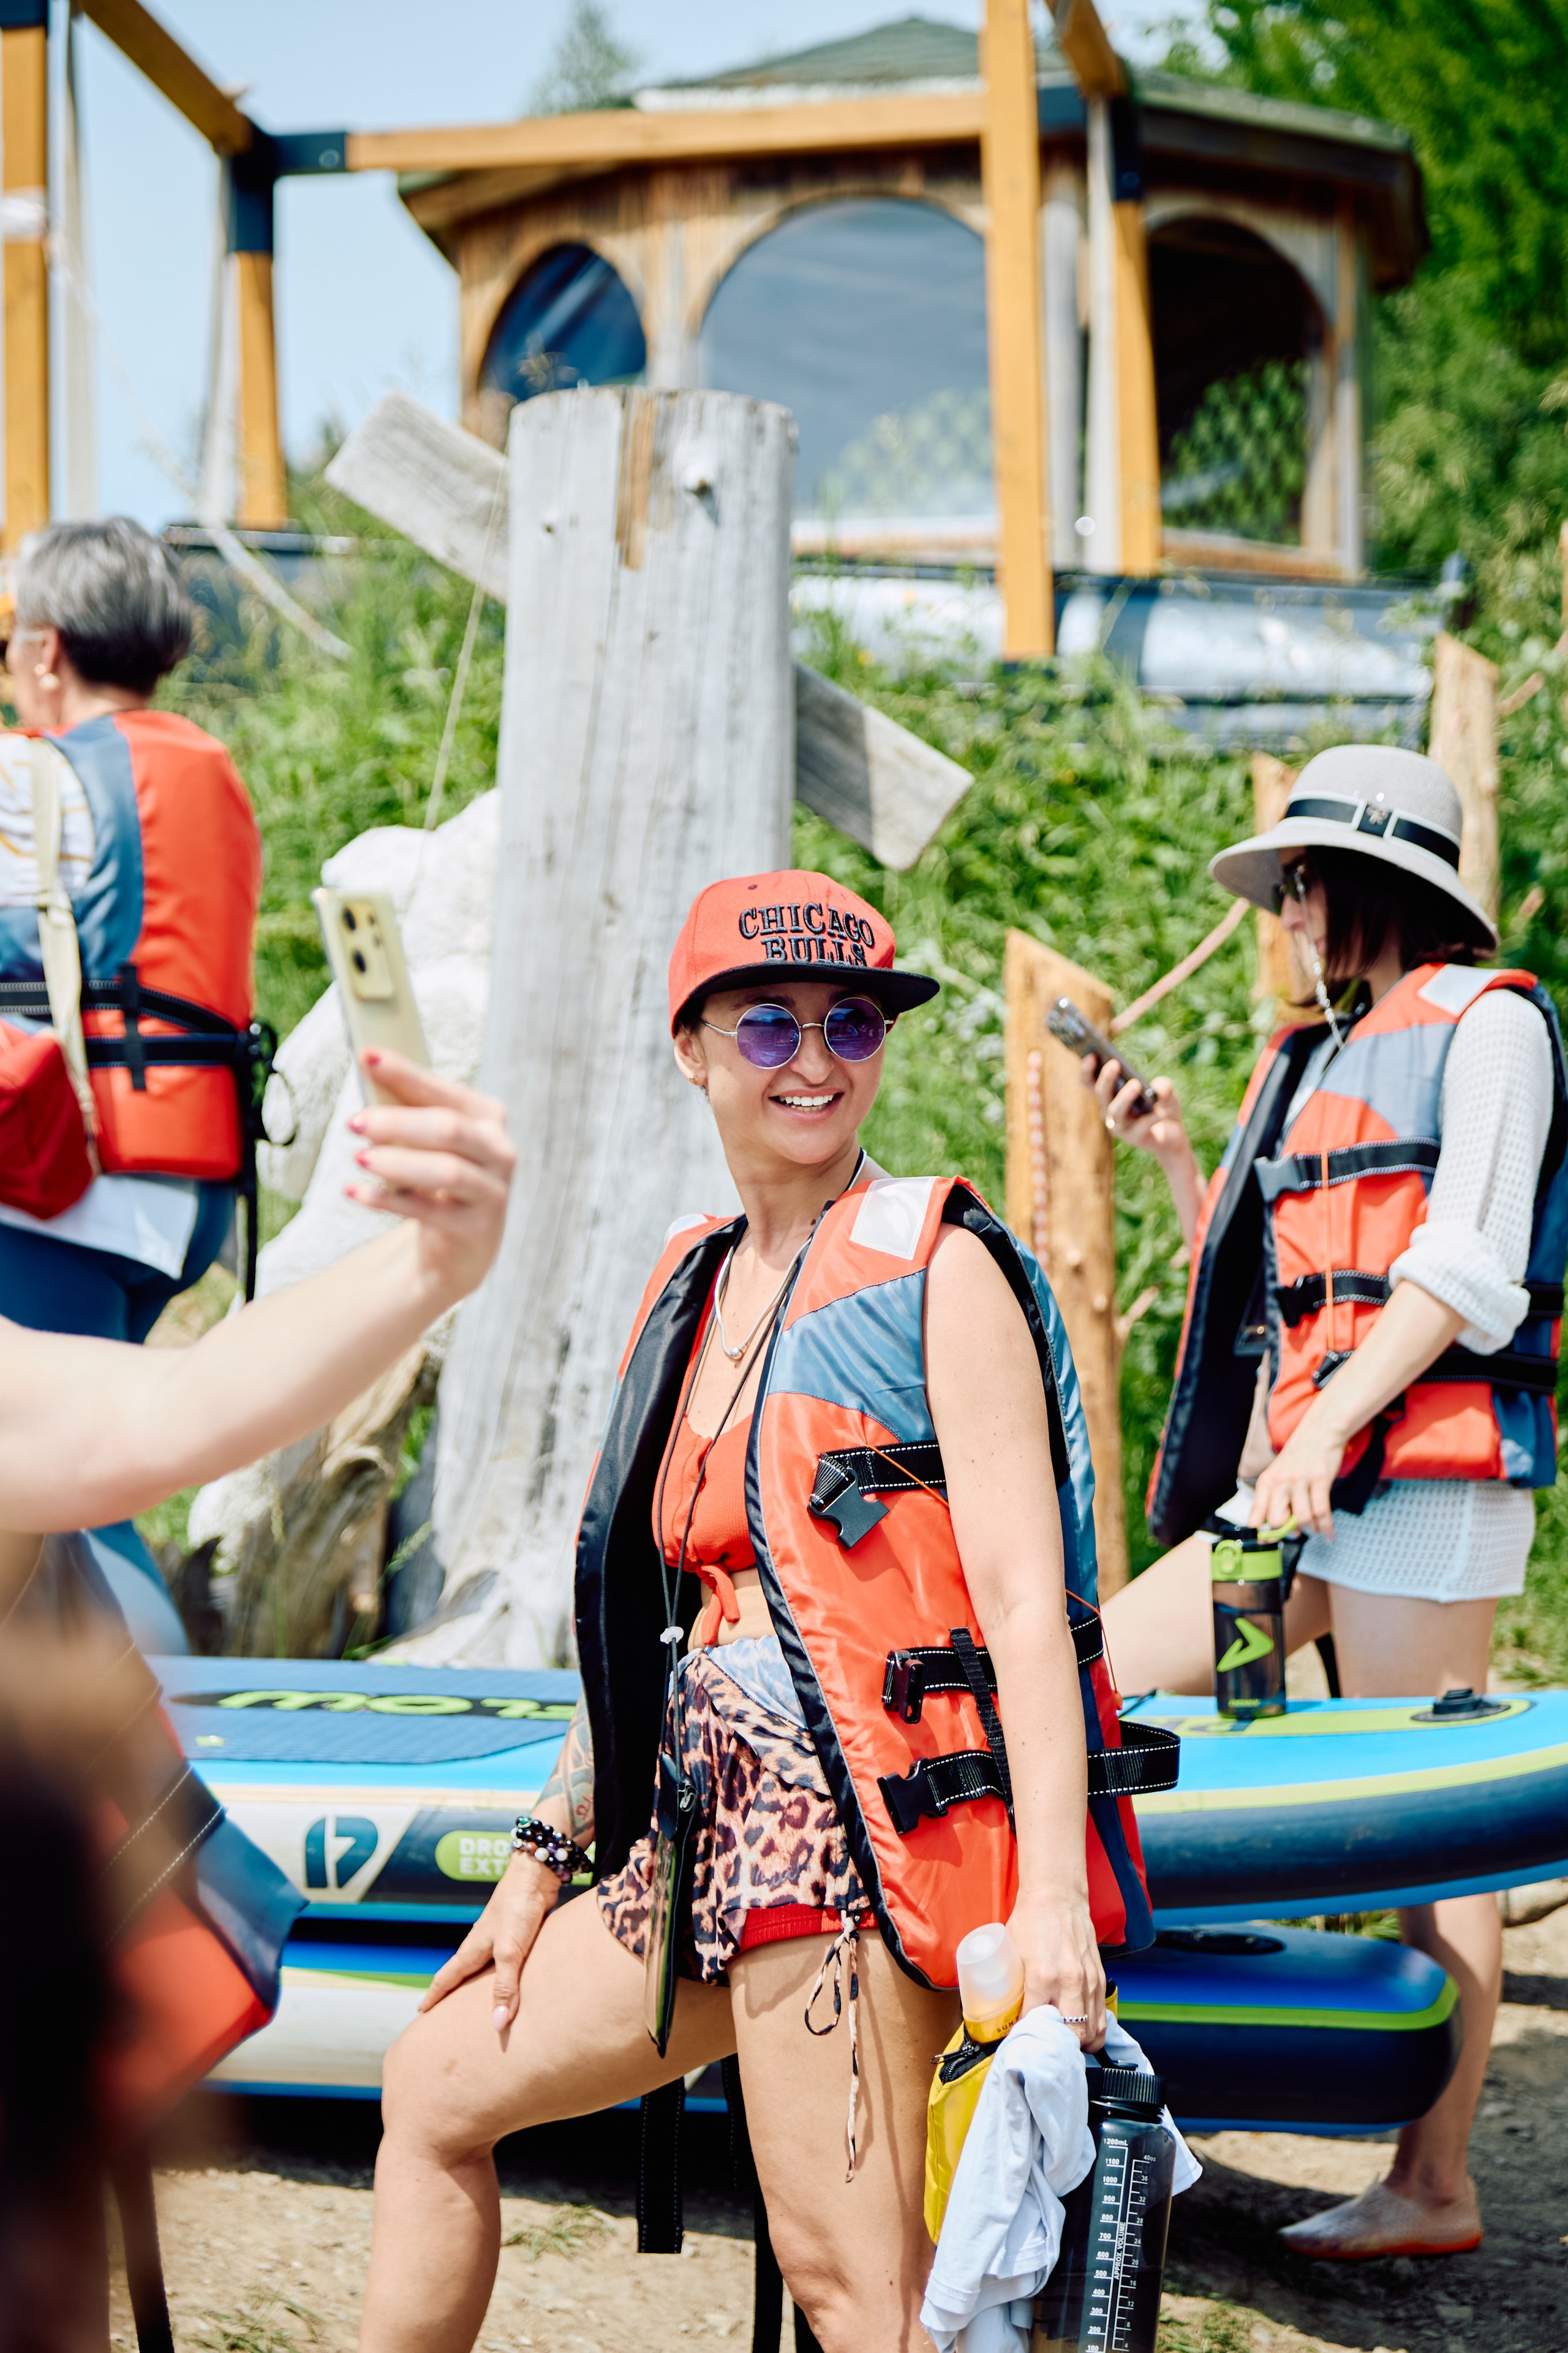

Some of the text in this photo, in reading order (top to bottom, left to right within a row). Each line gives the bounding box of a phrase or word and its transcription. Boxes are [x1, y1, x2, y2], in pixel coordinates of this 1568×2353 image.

[739, 902, 875, 947] CHICAGO
[761, 935, 867, 967] BULLS
[1103, 2137, 1128, 2146] 1200mL
[1114, 2221, 1126, 2280] APPROX. VOLUME
